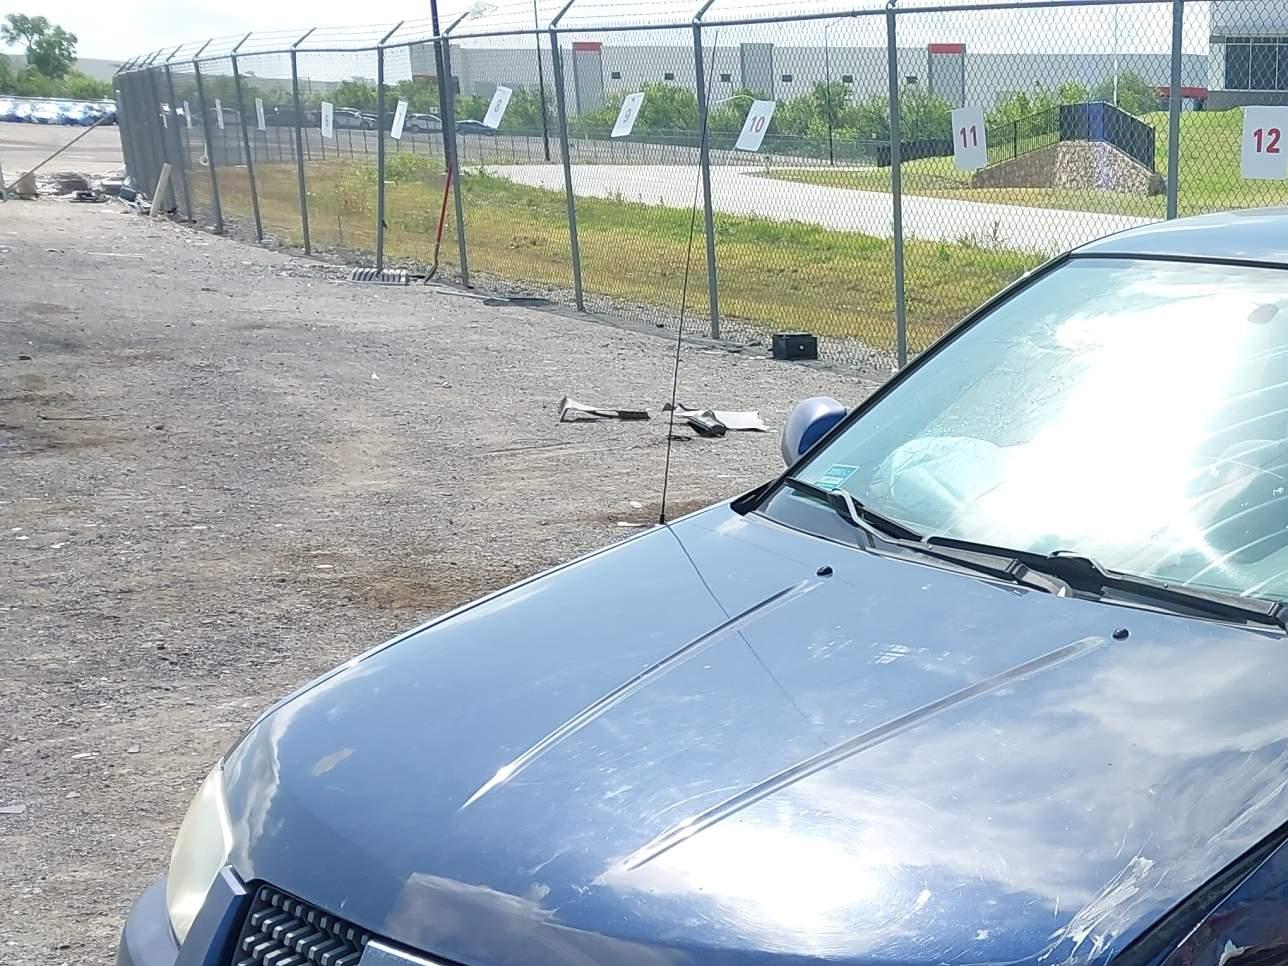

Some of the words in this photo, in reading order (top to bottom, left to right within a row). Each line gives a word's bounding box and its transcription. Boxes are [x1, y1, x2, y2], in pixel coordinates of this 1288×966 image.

[623, 108, 632, 124] 9
[750, 115, 766, 133] 10
[960, 125, 977, 148] 11
[1253, 128, 1280, 153] 12
